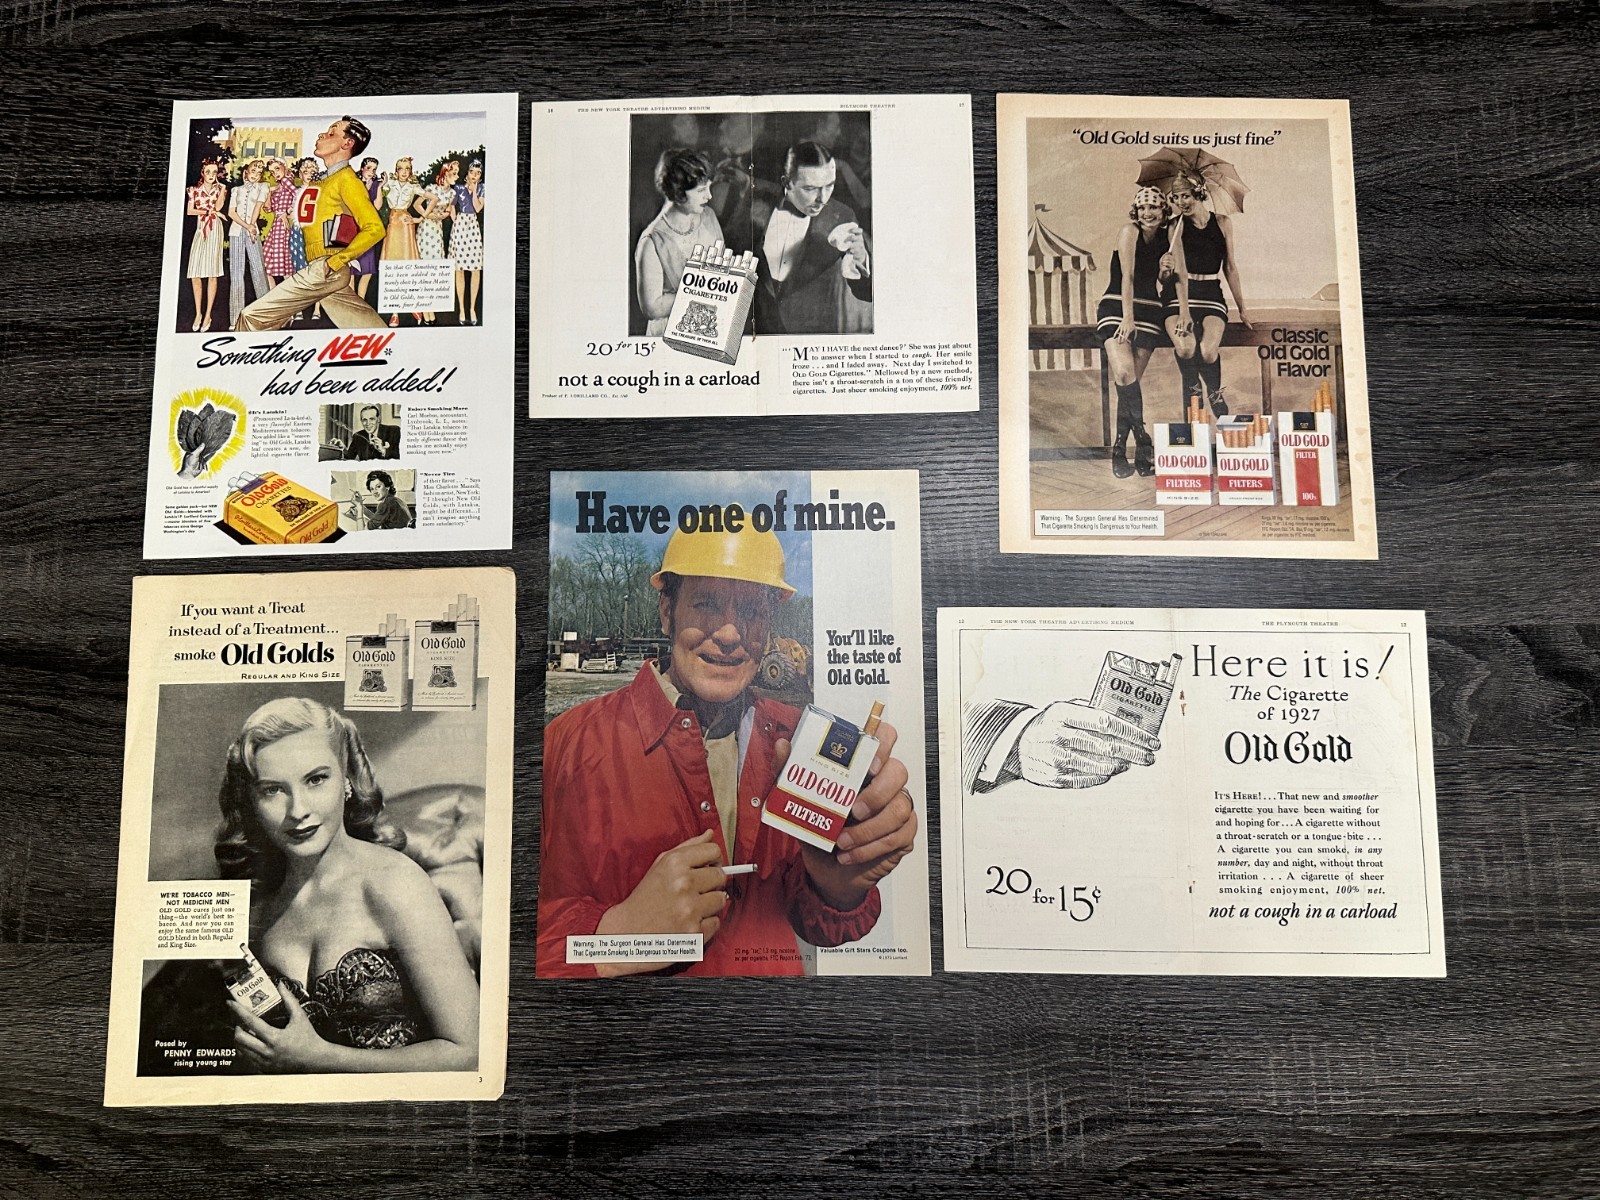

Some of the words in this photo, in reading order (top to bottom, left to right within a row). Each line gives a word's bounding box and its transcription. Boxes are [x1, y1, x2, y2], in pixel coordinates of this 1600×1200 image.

[1073, 129, 1108, 144] “Old
[1111, 130, 1149, 145] Gold
[1152, 132, 1189, 145] suits
[1193, 135, 1210, 145] us
[1212, 132, 1241, 148] just
[1245, 130, 1281, 145] fine”
[298, 189, 319, 223] G
[683, 273, 706, 288] Old
[707, 277, 738, 294] Gold
[683, 287, 727, 302] CIGARETTES
[1272, 329, 1329, 343] Classic
[197, 336, 318, 373] Something
[587, 343, 612, 356] 20
[616, 341, 632, 350] for
[635, 342, 657, 356] 15¢
[1258, 346, 1287, 361] Old
[1290, 346, 1329, 361] Gold
[1278, 363, 1331, 377] Flavor
[260, 370, 304, 396] has
[305, 368, 359, 395] been
[363, 367, 457, 393] added!
[559, 375, 588, 386] not
[593, 376, 603, 386] a
[608, 370, 659, 393] cough
[664, 372, 680, 386] in
[685, 375, 694, 385] a
[699, 371, 760, 385] carload
[1281, 434, 1301, 446] OLD
[1303, 435, 1329, 447] GOLD
[1158, 455, 1178, 468] OLD
[1180, 456, 1207, 468] GOLD
[1220, 459, 1240, 471] OLD
[1242, 459, 1269, 471] GOLD
[256, 486, 292, 508] CIGARETTES
[575, 491, 670, 533] Have
[678, 504, 744, 534] one
[752, 489, 787, 532] of
[794, 489, 896, 531] mine.
[181, 604, 194, 617] If
[193, 607, 218, 620] you
[221, 604, 254, 615] want
[268, 602, 305, 614] Treat
[169, 624, 222, 637] instead
[225, 624, 242, 636] of
[827, 630, 864, 646] You'll
[868, 631, 894, 645] like
[421, 638, 439, 649] Old
[442, 637, 465, 649] Gold
[174, 649, 216, 661] smoke
[221, 643, 264, 665] Old
[267, 642, 335, 664] Golds
[353, 650, 371, 662] Old
[372, 650, 395, 662] Gold
[827, 649, 849, 664] the
[852, 650, 885, 663] taste
[888, 648, 902, 663] of
[1192, 644, 1288, 677] Here
[1304, 650, 1328, 677] it
[1343, 645, 1394, 679] is!
[828, 669, 852, 685] Old
[855, 669, 889, 685] Gold.
[1111, 678, 1132, 694] Old
[1135, 686, 1163, 706] Gold
[1230, 685, 1261, 700] The
[1267, 685, 1349, 705] Cigarette
[1257, 707, 1274, 720] of
[1282, 708, 1320, 724] 1927
[1225, 731, 1278, 764] Old
[1284, 731, 1352, 764] Gold
[810, 758, 828, 769] KING
[832, 768, 849, 778] SIZE
[787, 764, 818, 790] OLD
[816, 777, 856, 807] GOLD
[784, 801, 833, 831] FILTERS
[1330, 806, 1362, 814] waiting
[1254, 859, 1269, 867] day
[1292, 859, 1316, 867] night,
[986, 866, 1032, 895] 20
[1032, 888, 1055, 903] for
[1059, 885, 1101, 921] 15¢
[1209, 905, 1235, 918] not
[1240, 908, 1249, 918] a
[1255, 903, 1300, 926] cough
[1306, 904, 1322, 918] in
[1326, 908, 1335, 918] a
[1341, 903, 1397, 918] carload
[237, 984, 250, 997] Old
[248, 976, 264, 990] Gold
[178, 1040, 187, 1048] by
